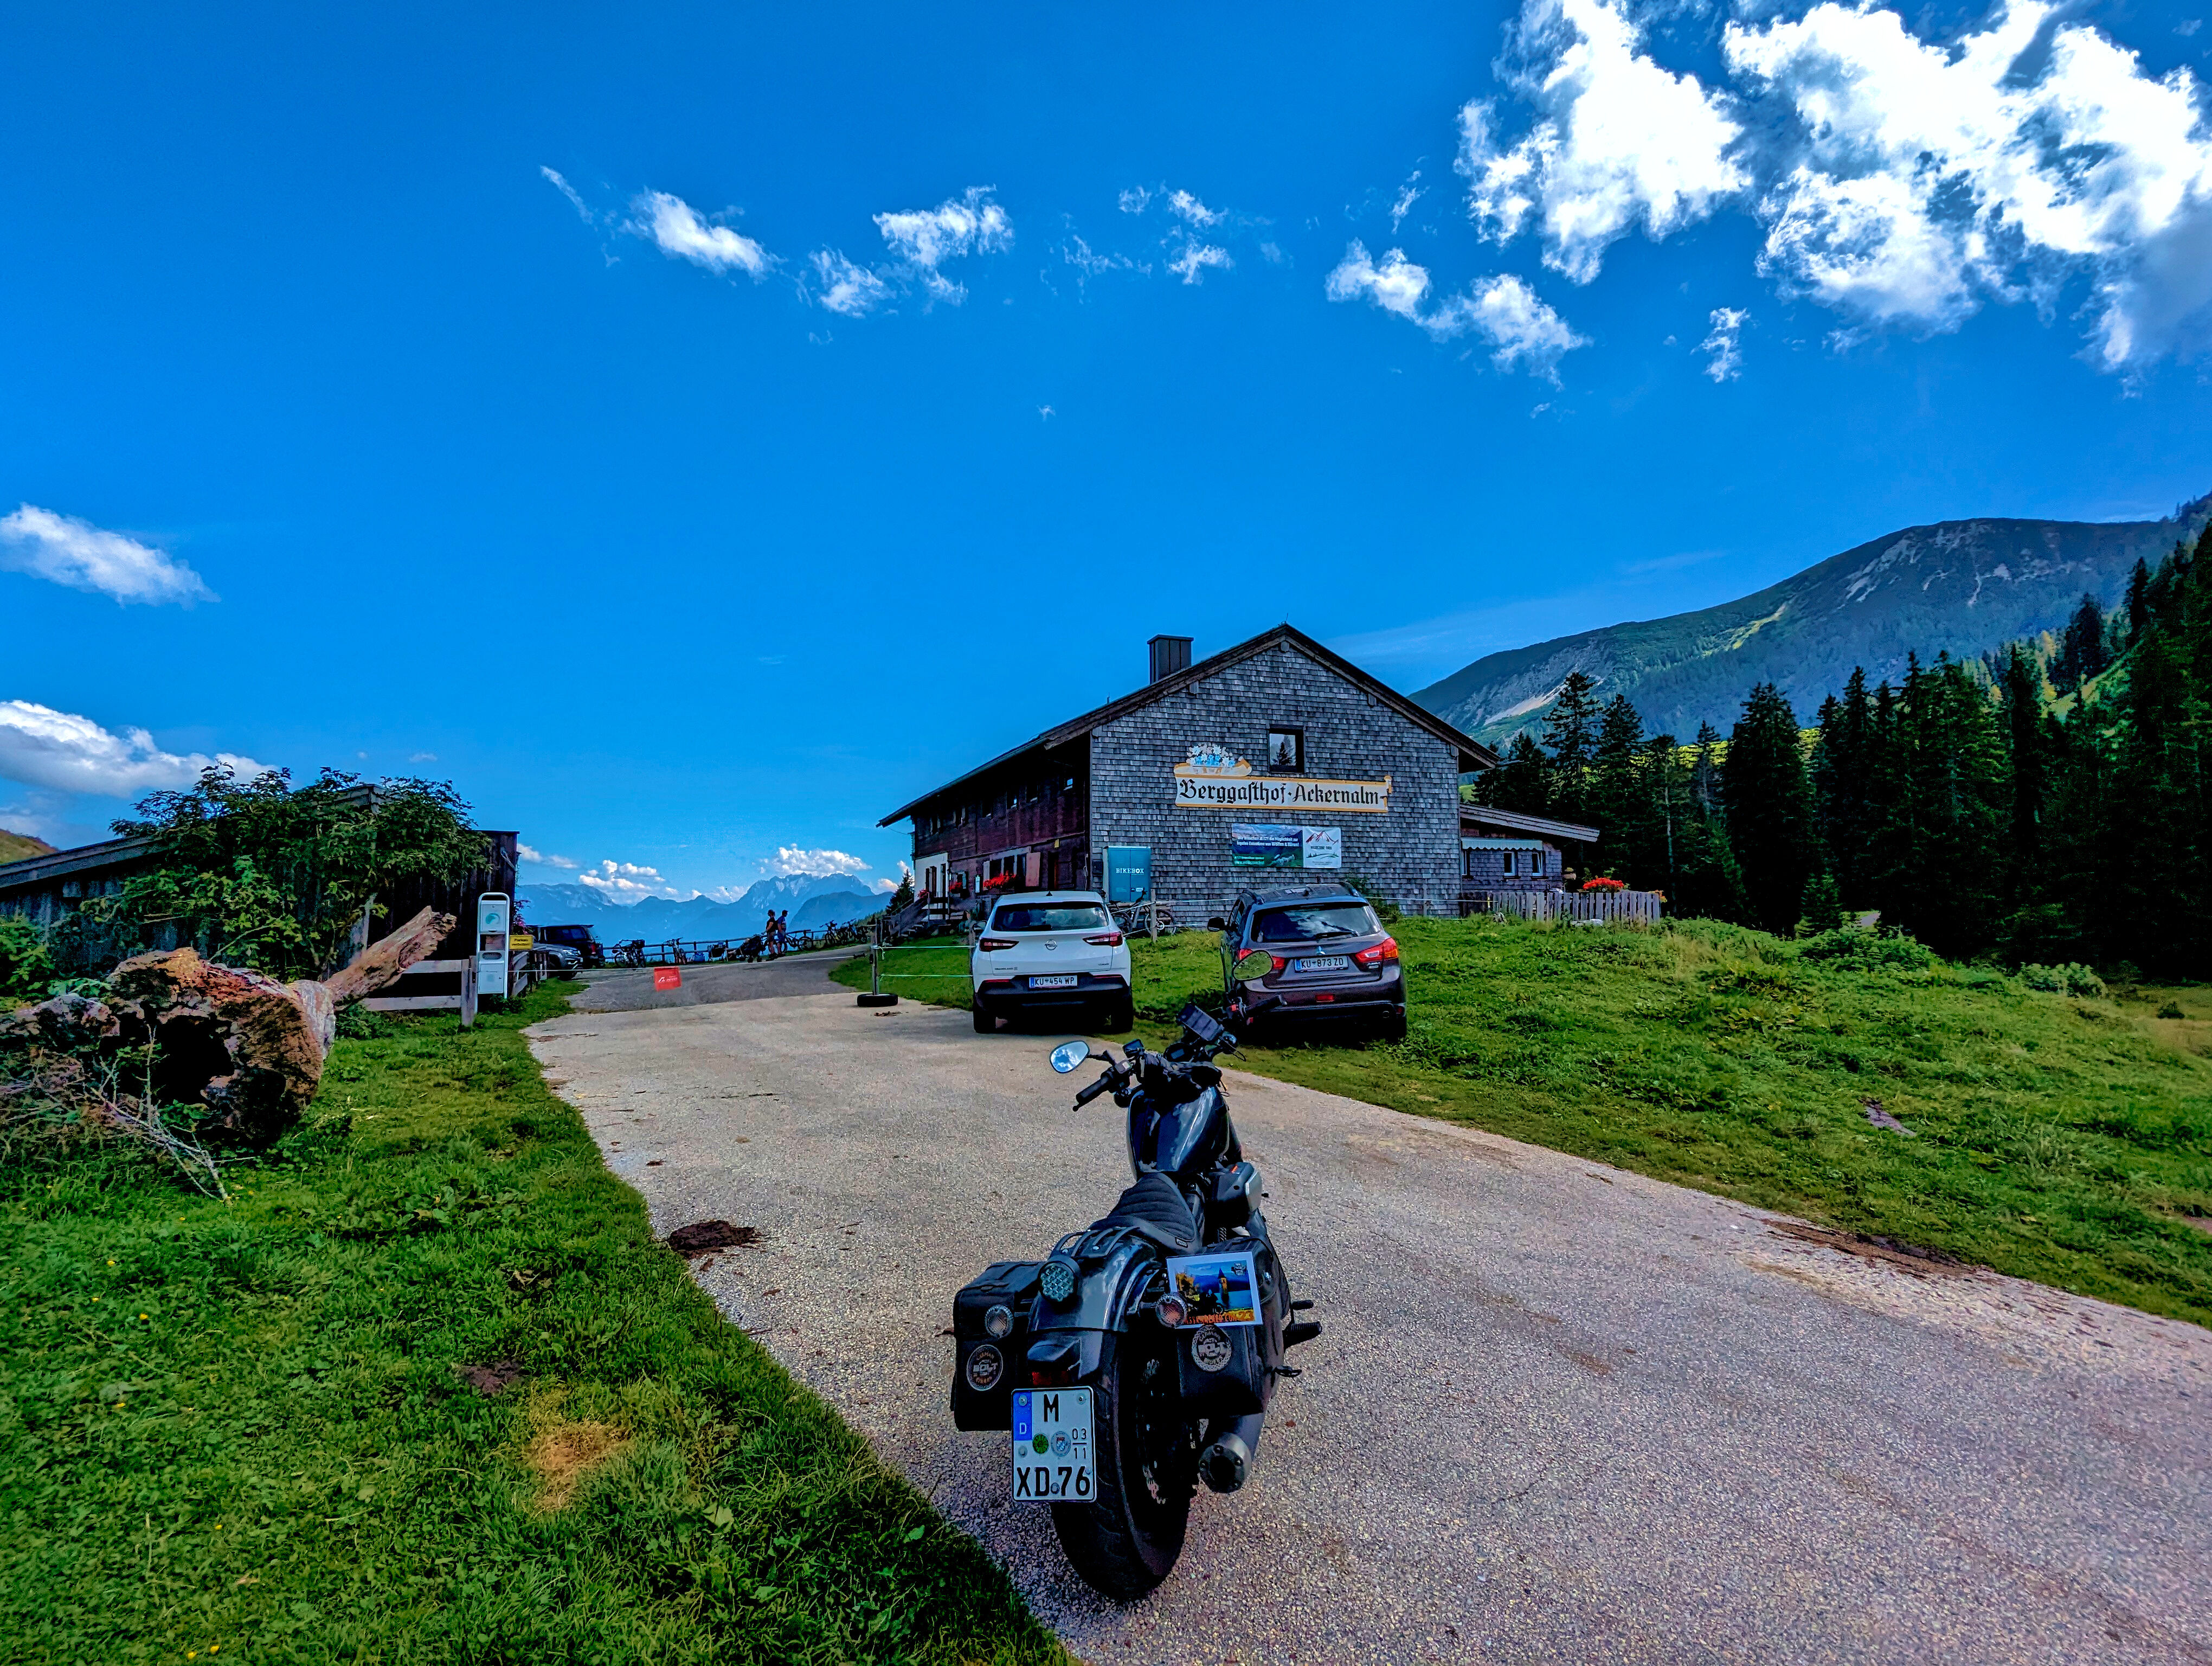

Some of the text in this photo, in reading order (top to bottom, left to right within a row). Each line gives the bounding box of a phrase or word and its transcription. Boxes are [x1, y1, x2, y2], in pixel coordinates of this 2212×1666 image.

[1293, 783, 1378, 804] Ackernalm
[1301, 958, 1344, 969] KU 873 ZD
[1043, 1393, 1059, 1422] M
[1019, 1422, 1027, 1434] D
[1072, 1428, 1087, 1439] 03
[1074, 1447, 1086, 1459] 11
[1058, 1466, 1090, 1496] 76
